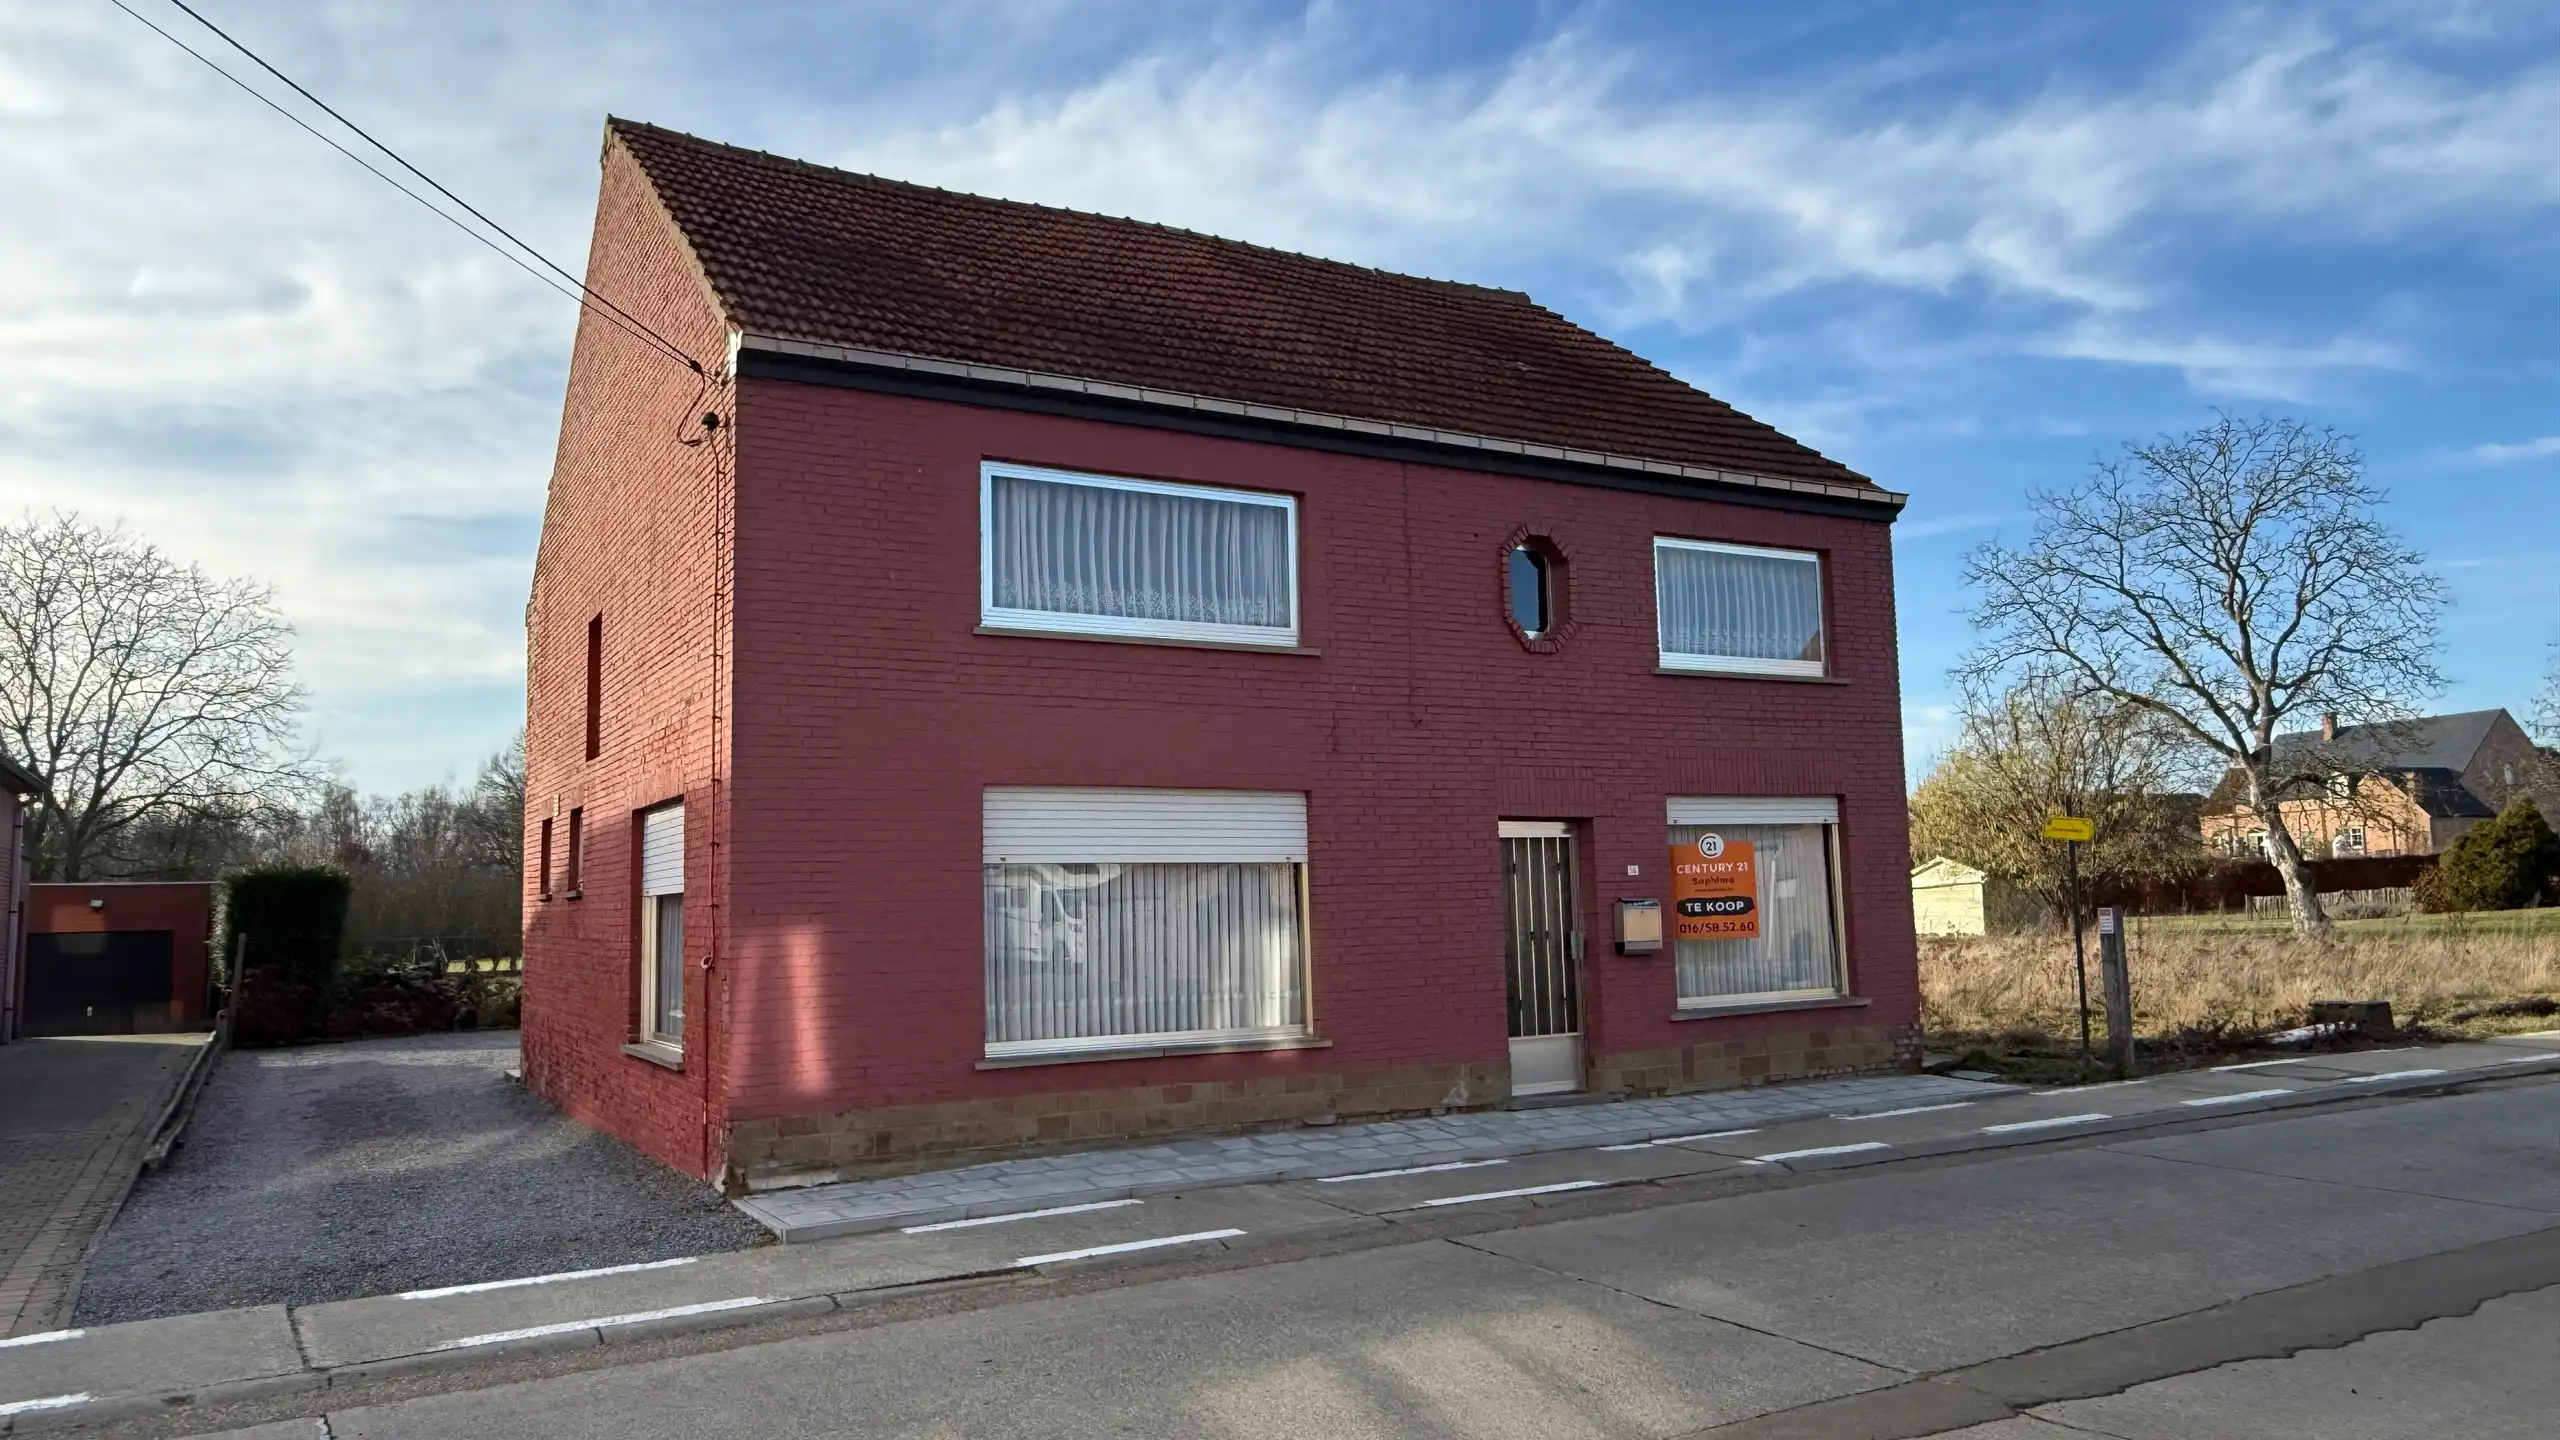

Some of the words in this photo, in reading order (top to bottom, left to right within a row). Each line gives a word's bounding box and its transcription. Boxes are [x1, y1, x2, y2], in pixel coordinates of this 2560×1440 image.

[1676, 862, 1734, 874] CENTURY
[1737, 861, 1748, 872] 21
[1685, 902, 1702, 913] TE
[1706, 901, 1744, 912] KOOP
[1680, 921, 1754, 934] 016/58.52.60
